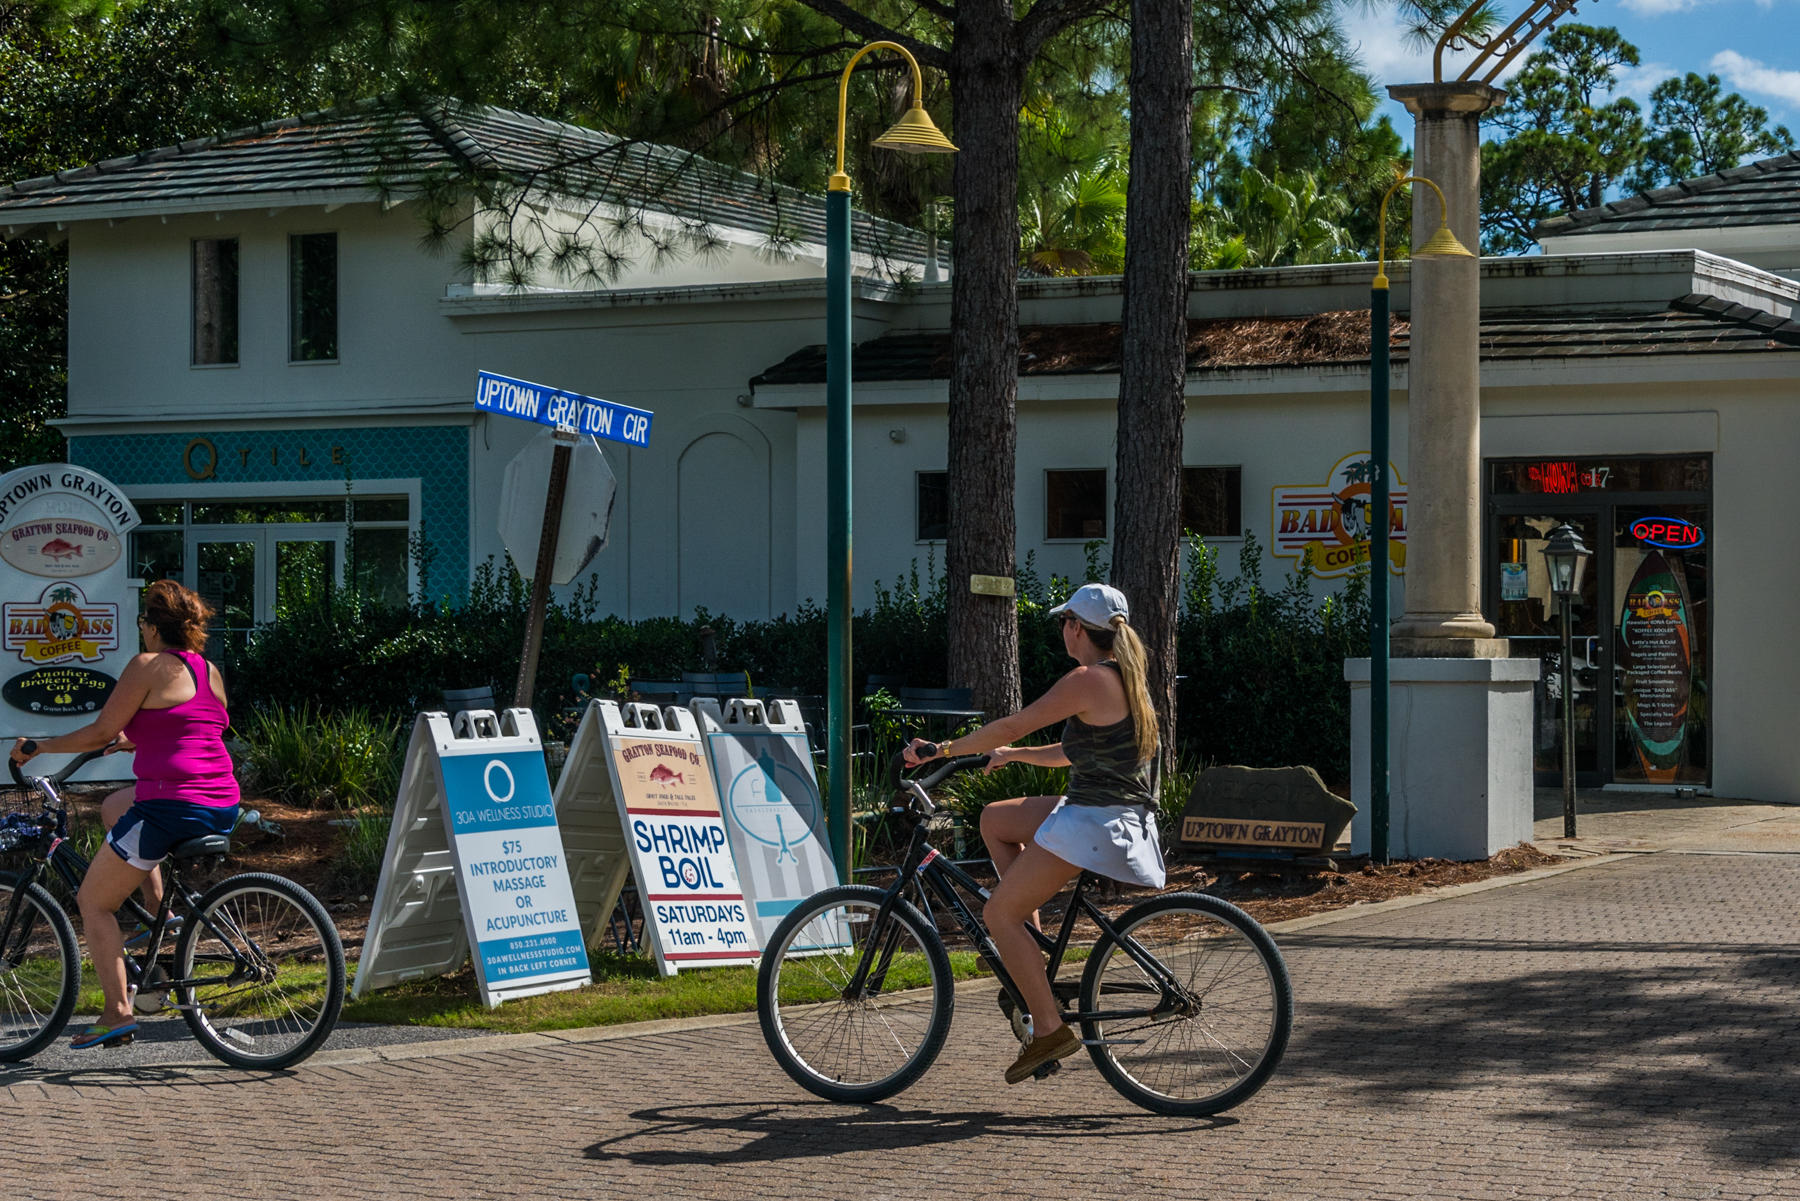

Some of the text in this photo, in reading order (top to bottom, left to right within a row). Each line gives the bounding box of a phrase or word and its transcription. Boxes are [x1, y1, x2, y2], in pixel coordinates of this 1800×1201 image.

[476, 377, 648, 444] UPTOWN GRAYTON CIR
[184, 437, 345, 480] Q TILE
[61, 473, 131, 526] GRAYTON
[1278, 509, 1340, 534] BAD
[12, 523, 52, 542] GRAYTON
[55, 522, 94, 537] SEAFOOD
[1633, 523, 1698, 543] OPEN
[8, 618, 113, 635] BAD ASS
[40, 640, 81, 657] COFFEE
[20, 677, 106, 690] Broken Egg
[32, 668, 91, 680] Another
[622, 743, 654, 763] GRAYTON
[654, 743, 687, 760] SEAFOOD
[456, 804, 553, 824] 30A WELLNESS STUDIO
[633, 820, 725, 854] SHRIMP
[1185, 821, 1322, 844] UPTOWN GRAYTON
[502, 840, 522, 855] $75
[470, 855, 558, 877] INTRODUCTORY
[658, 855, 724, 890] BOIL
[493, 875, 547, 893] MASSAGE
[515, 895, 533, 909] OR
[486, 909, 569, 932] ACUPUNCTURE
[657, 904, 745, 923] SATURDAYS
[668, 928, 705, 946] 11am
[717, 927, 747, 948] 4pm
[487, 945, 581, 965] 30AWELLNESSSTUDIO.COM
[497, 957, 577, 975] IN BACK LEFT CORNER
